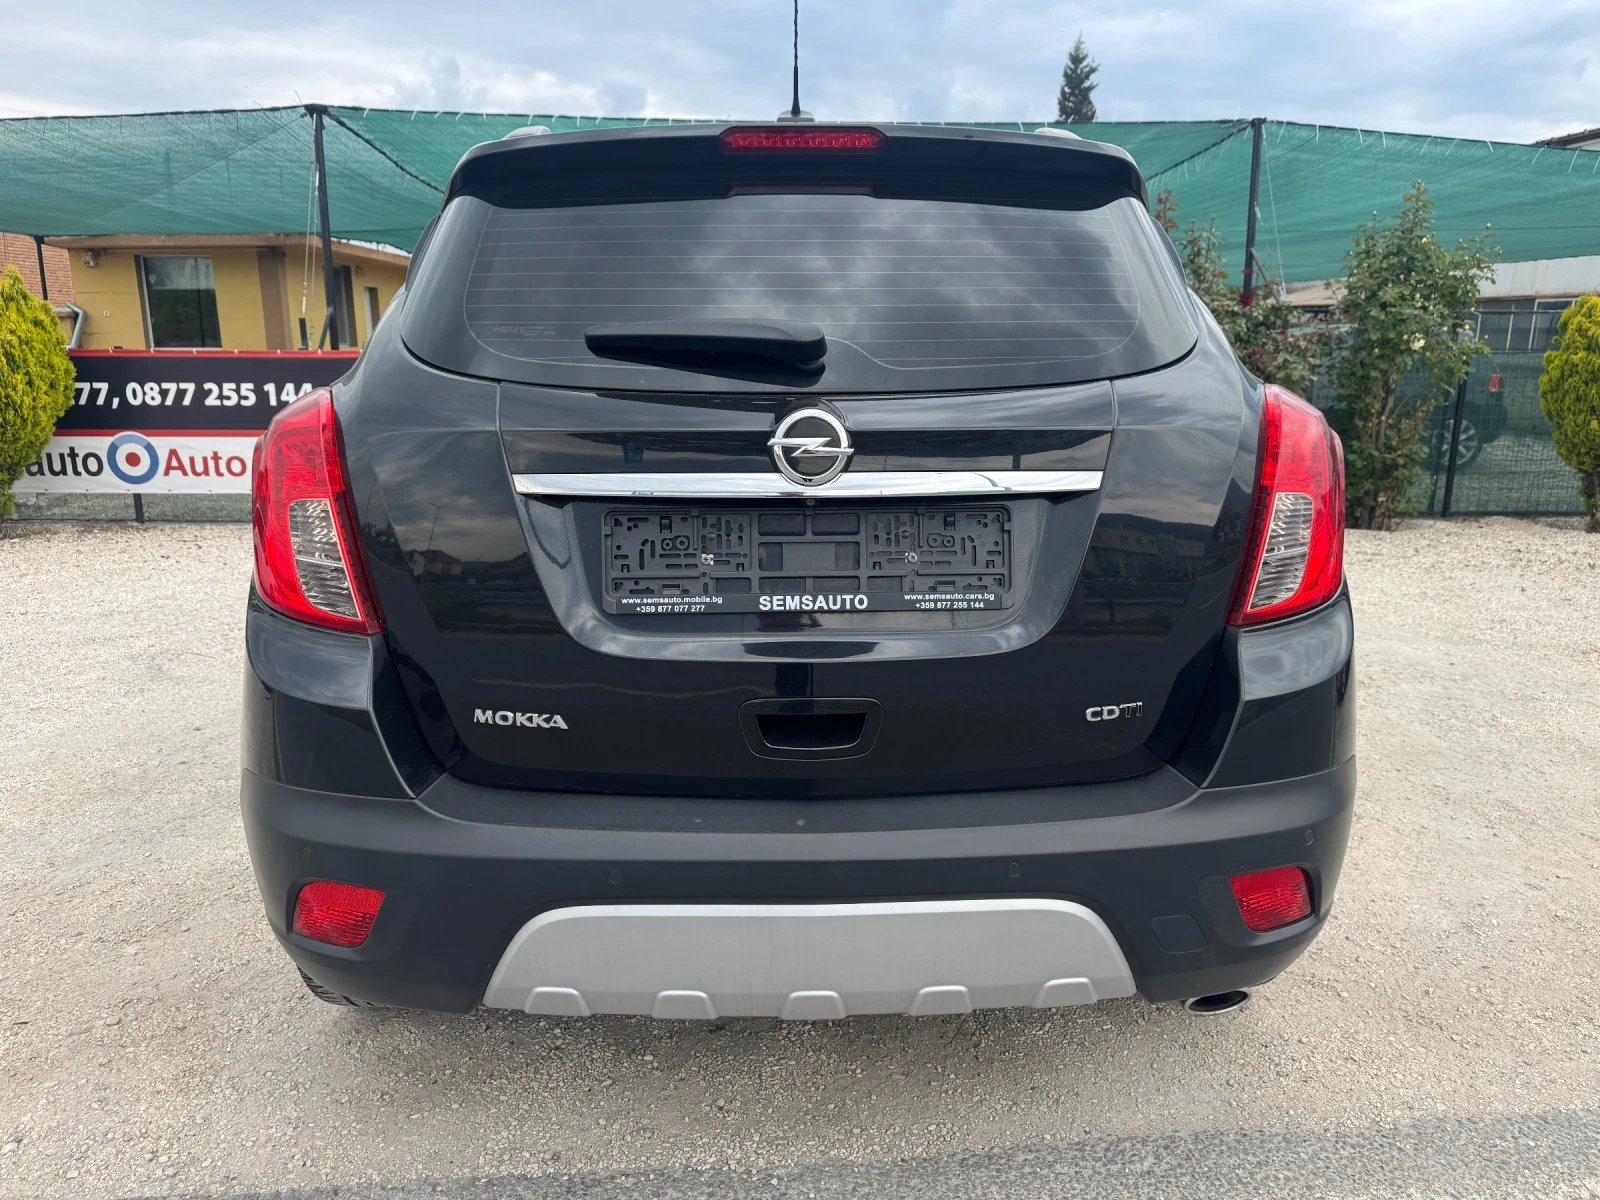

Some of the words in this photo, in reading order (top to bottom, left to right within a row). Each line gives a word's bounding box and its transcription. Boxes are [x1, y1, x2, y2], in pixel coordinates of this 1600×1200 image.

[72, 382, 120, 409] 77,
[126, 381, 195, 406] 0877
[203, 382, 257, 406] 255
[163, 448, 247, 477] Auto
[621, 596, 723, 604] www.semsauto.mobile.bg
[759, 595, 868, 611] SEMSAUTO
[903, 592, 995, 601] www.semsauto.cars.bg
[636, 605, 656, 613] +359
[657, 605, 672, 613] 877
[674, 605, 689, 613] 077
[970, 601, 985, 609] 144
[473, 708, 569, 730] MOKKA
[1085, 701, 1143, 721] CDTI
